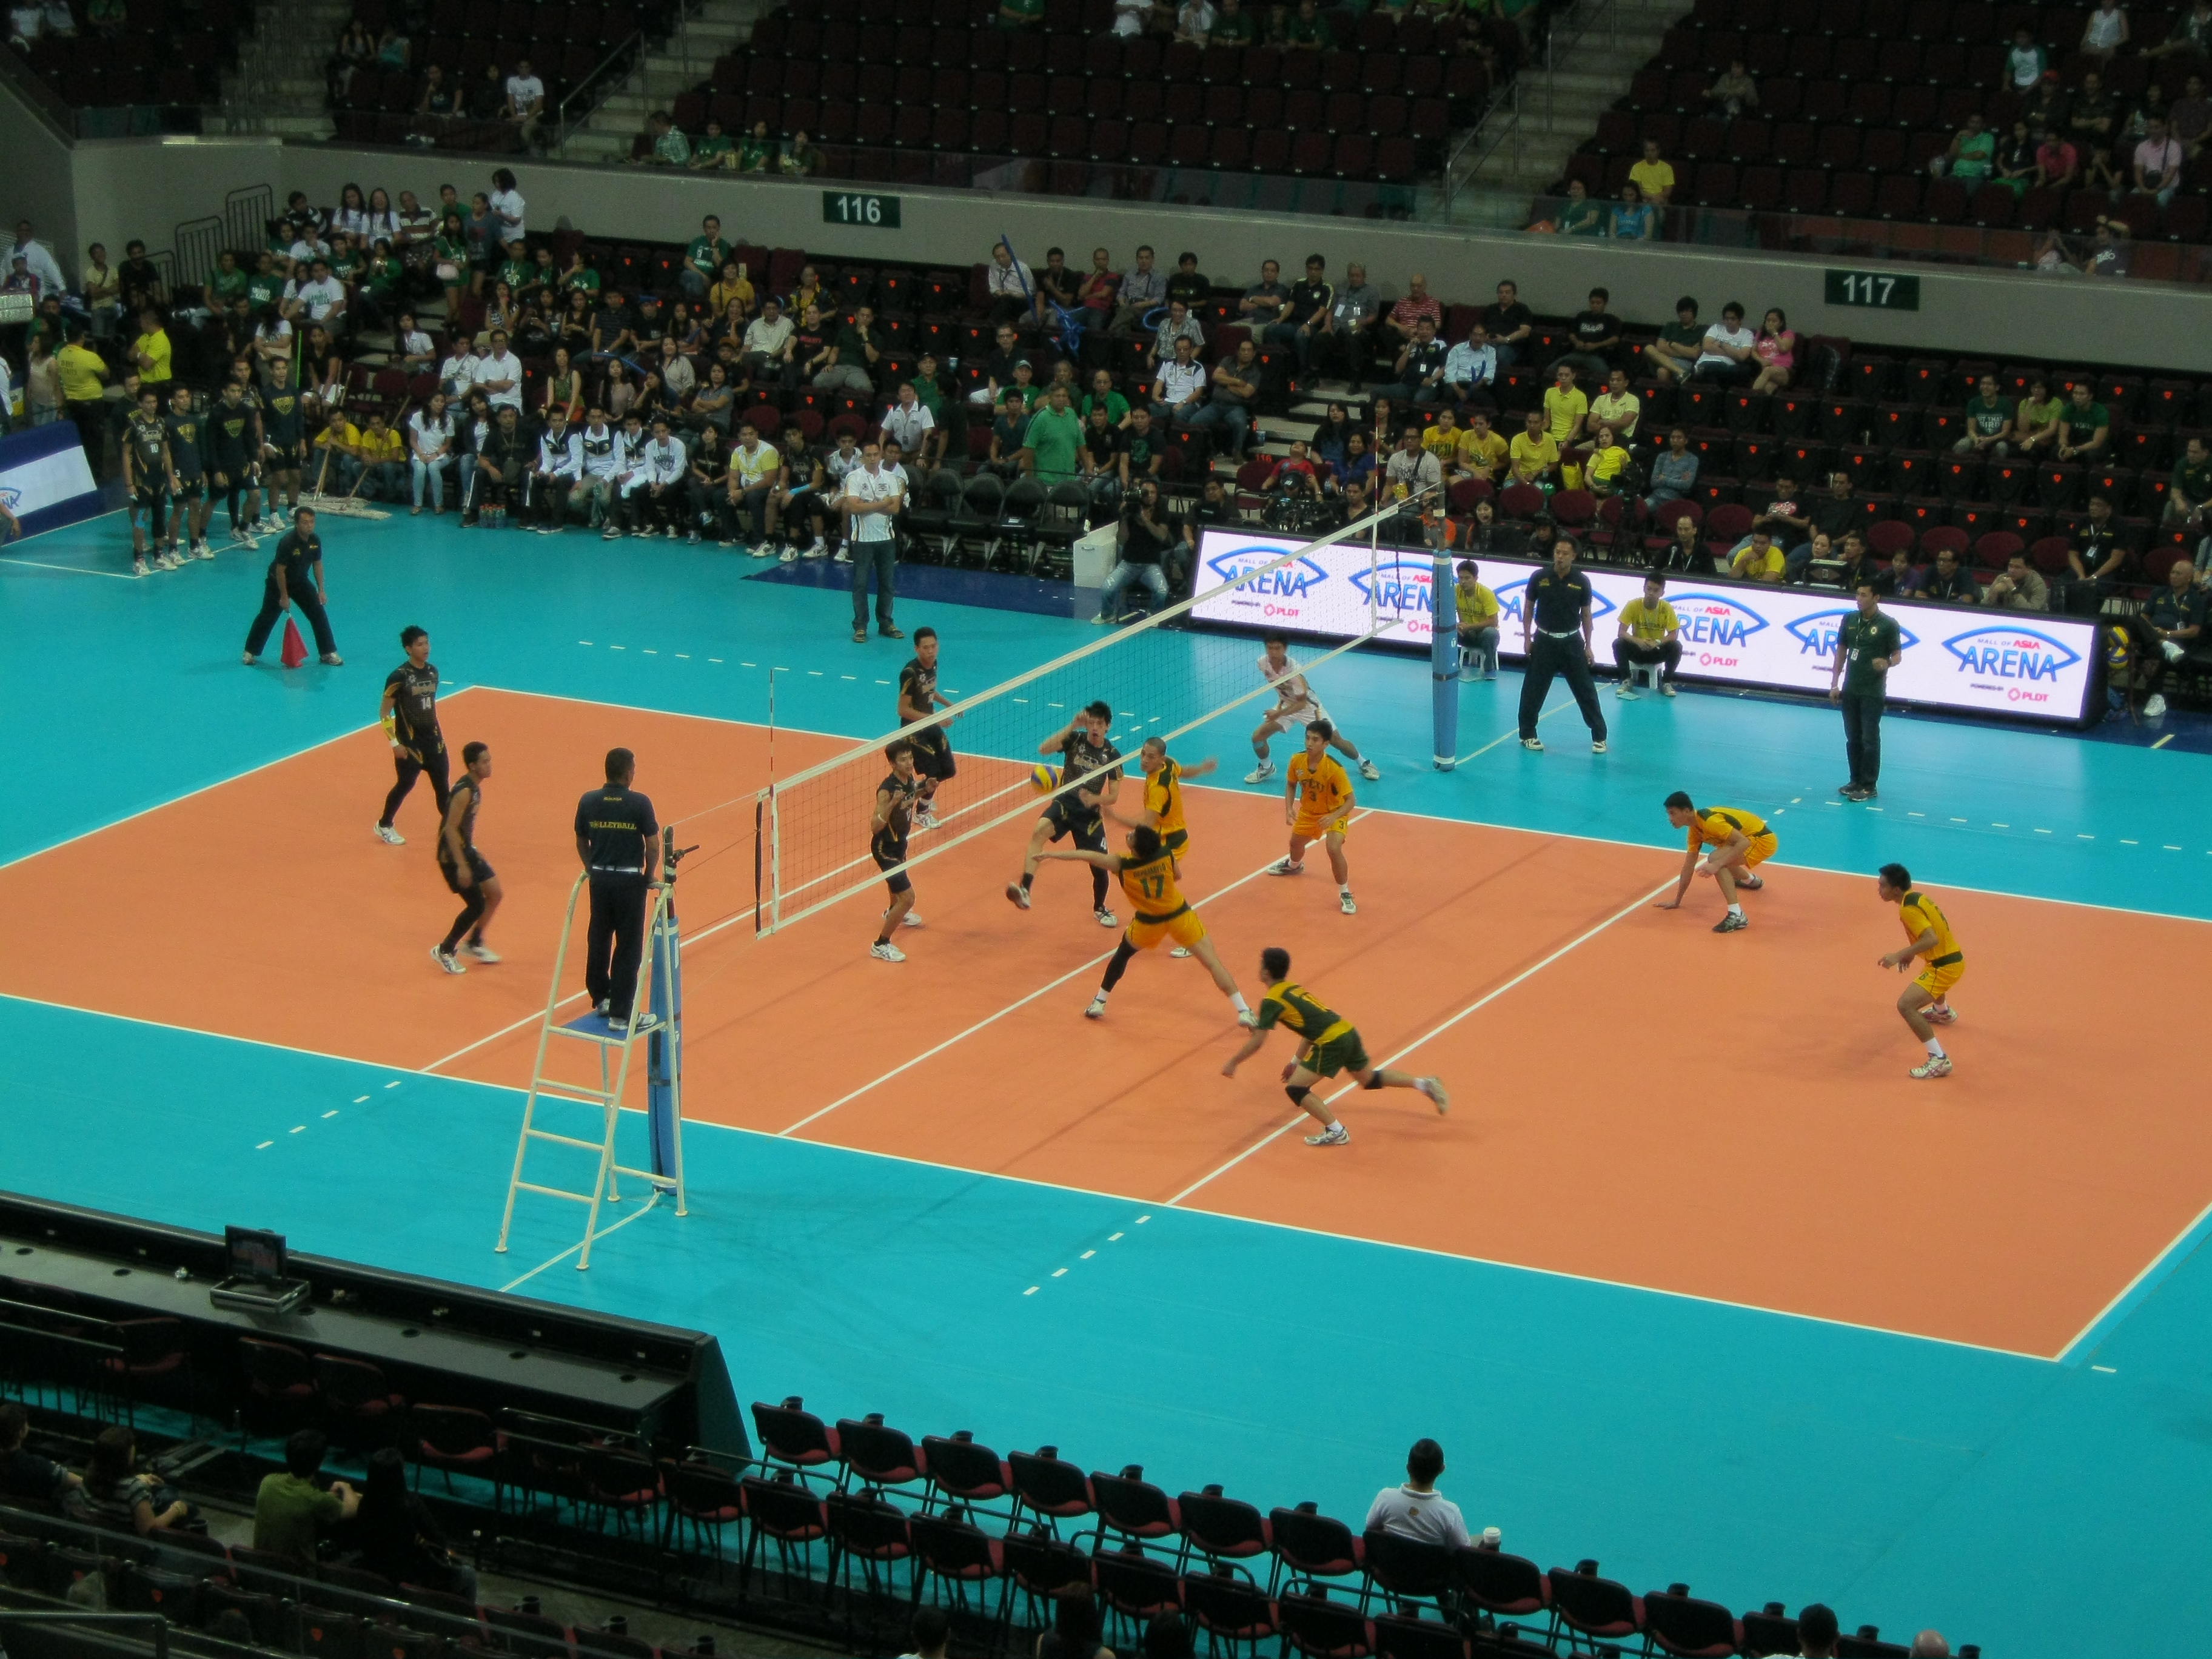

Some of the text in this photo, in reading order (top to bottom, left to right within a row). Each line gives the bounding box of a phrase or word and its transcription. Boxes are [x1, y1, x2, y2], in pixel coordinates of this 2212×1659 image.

[838, 196, 881, 223] 116
[1843, 275, 1895, 304] 117
[150, 443, 158, 453] 10
[1363, 581, 1433, 612] AREN
[1276, 608, 1299, 617] PLDT
[1705, 606, 1731, 615] ASIA
[1677, 614, 1746, 648] RENA
[2013, 640, 2040, 649] ASIA
[1713, 657, 1739, 666] PLDT
[1958, 646, 2057, 682] ARENA
[2022, 692, 2049, 702] PLDT
[421, 697, 431, 709] 14
[1338, 820, 1344, 830] 3
[1140, 873, 1164, 899] 17
